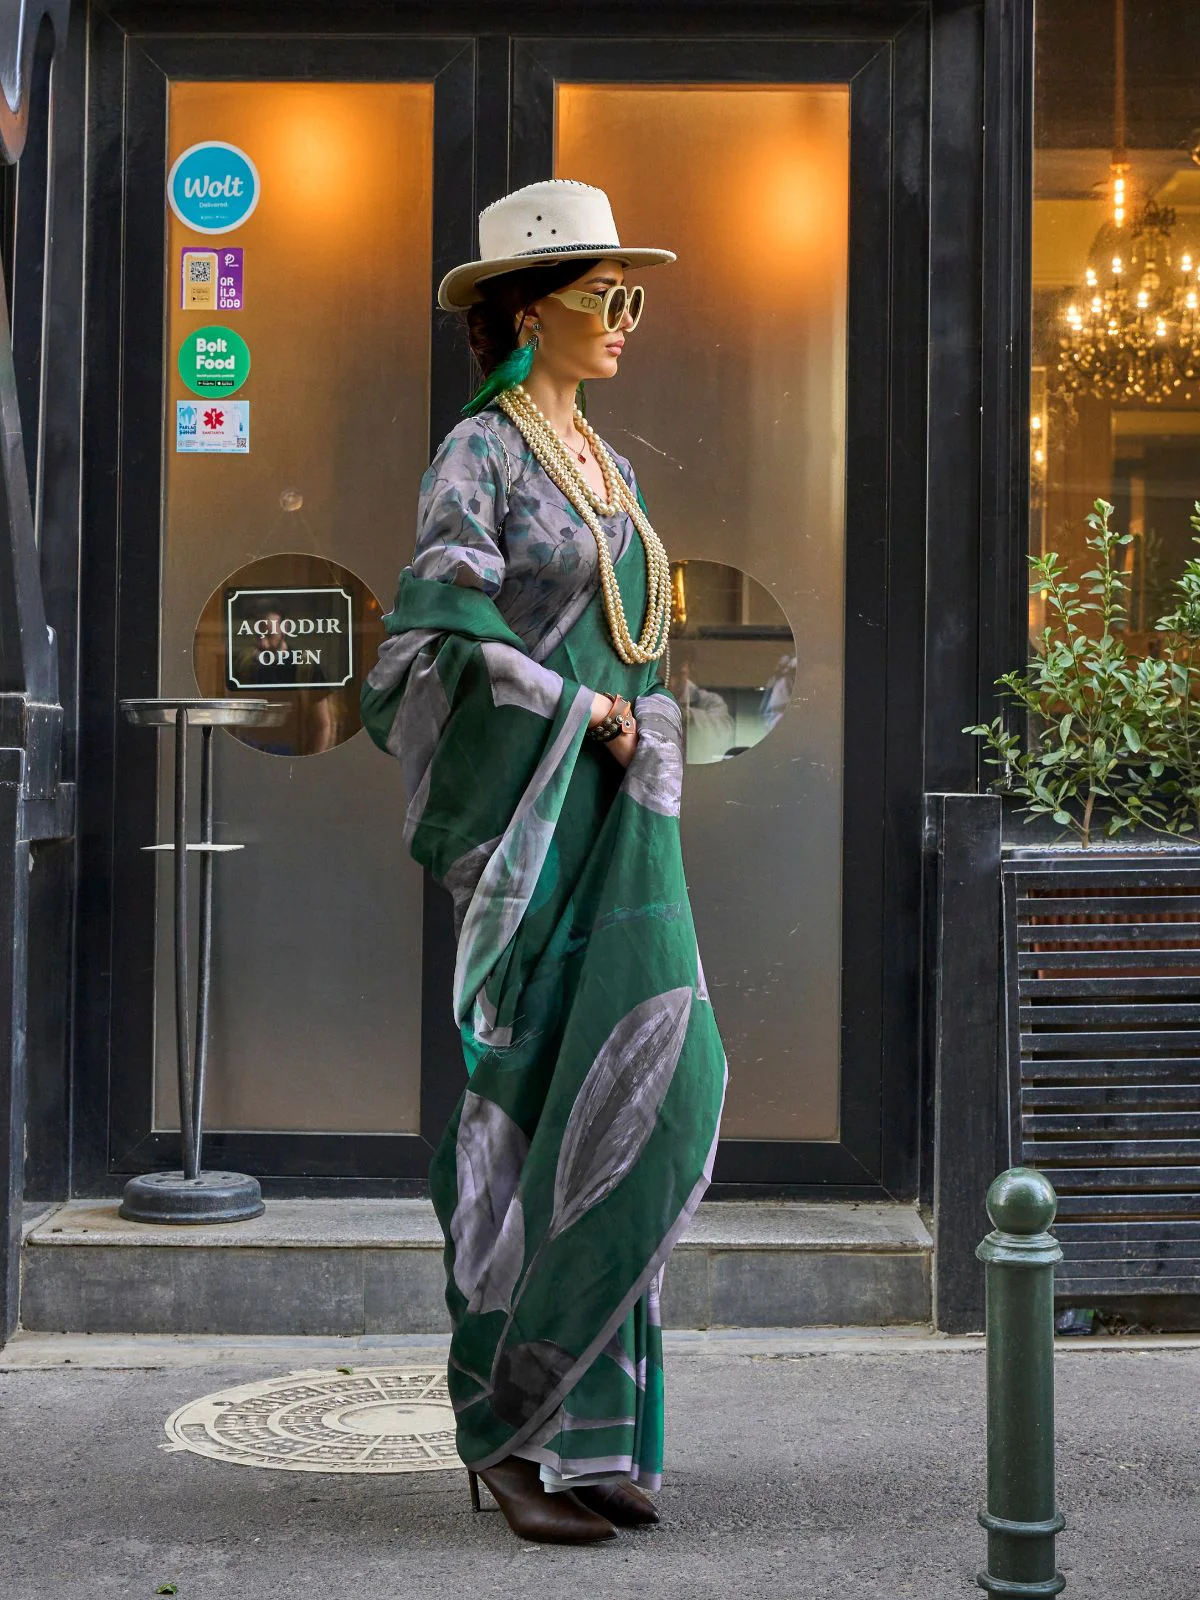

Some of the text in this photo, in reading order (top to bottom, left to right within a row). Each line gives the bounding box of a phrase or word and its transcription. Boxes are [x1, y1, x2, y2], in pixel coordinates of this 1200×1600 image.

[184, 174, 244, 198] Wolt
[220, 277, 234, 286] QR
[196, 338, 227, 356] Bolt
[196, 355, 235, 370] Food
[237, 618, 343, 639] AÇIQDIR
[258, 649, 322, 666] OPEN
